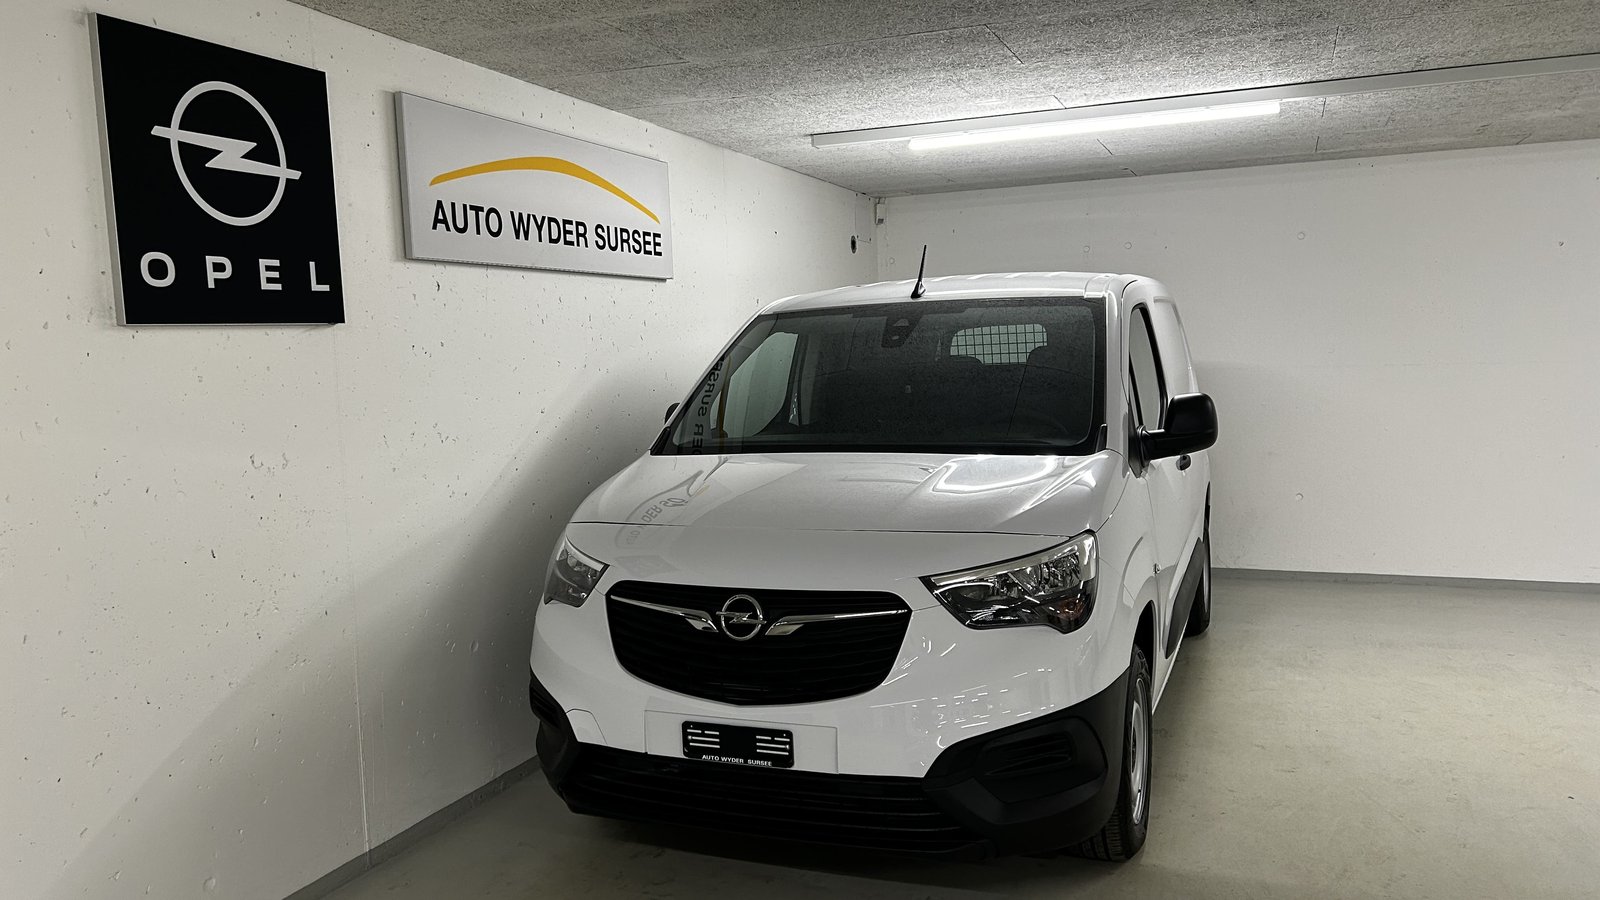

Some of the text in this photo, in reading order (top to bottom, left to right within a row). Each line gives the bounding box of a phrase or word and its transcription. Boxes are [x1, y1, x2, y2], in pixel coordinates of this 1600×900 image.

[431, 199, 663, 257] AUTO WYDER SURSEE
[140, 251, 330, 292] OPEL
